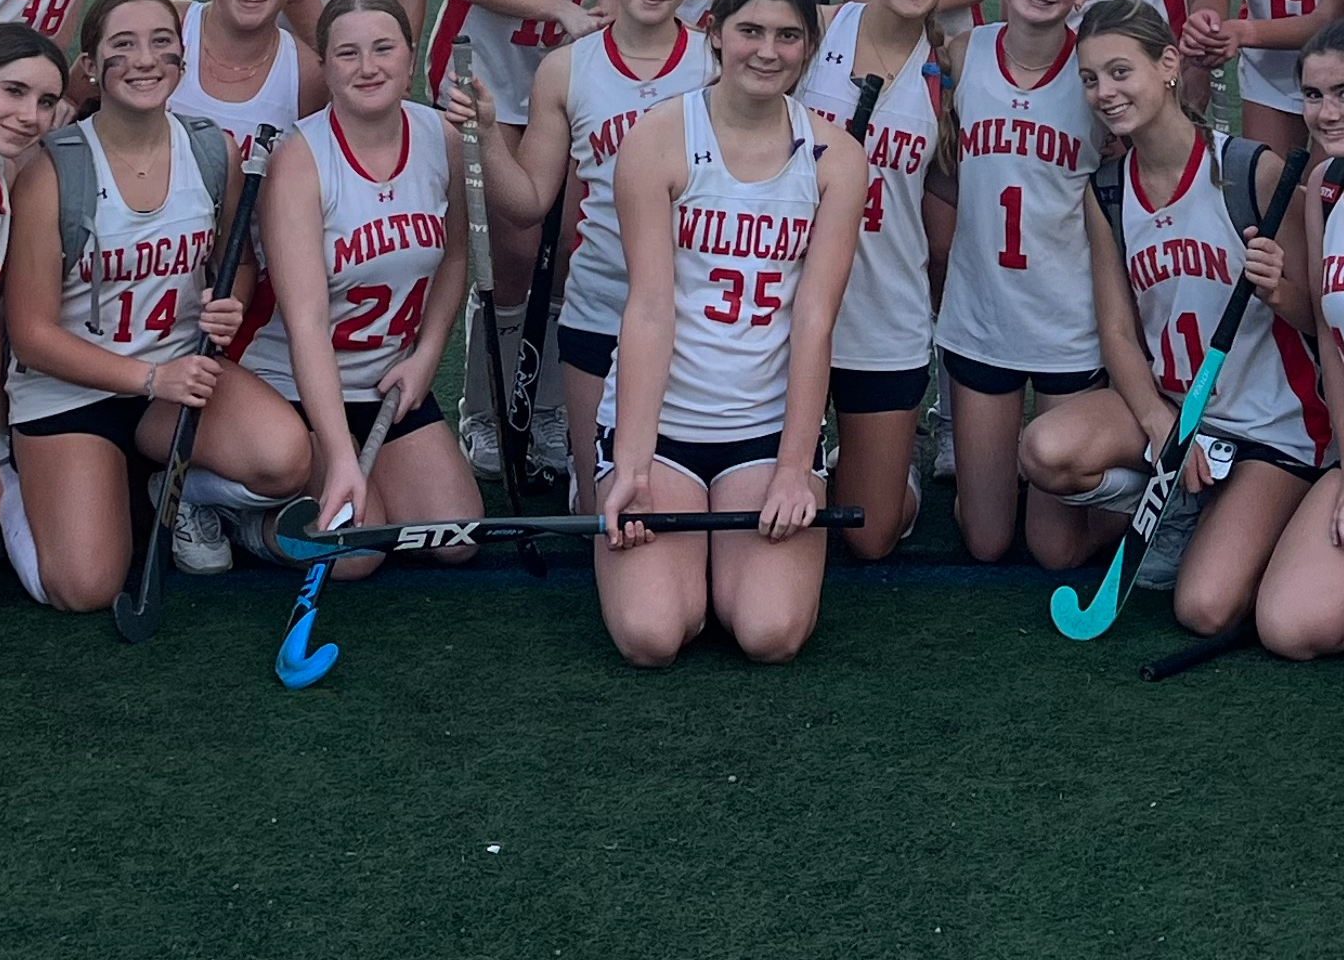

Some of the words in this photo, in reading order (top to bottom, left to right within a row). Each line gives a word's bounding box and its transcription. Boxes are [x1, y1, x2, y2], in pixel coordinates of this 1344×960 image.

[958, 118, 1081, 172] MILTON
[333, 213, 446, 275] MILTON
[998, 185, 1027, 270] 1
[113, 288, 178, 343] 14
[331, 276, 429, 352] 24
[704, 267, 782, 327] 35
[162, 450, 191, 529] STX
[1132, 458, 1177, 543] STX
[393, 521, 481, 552] STX
